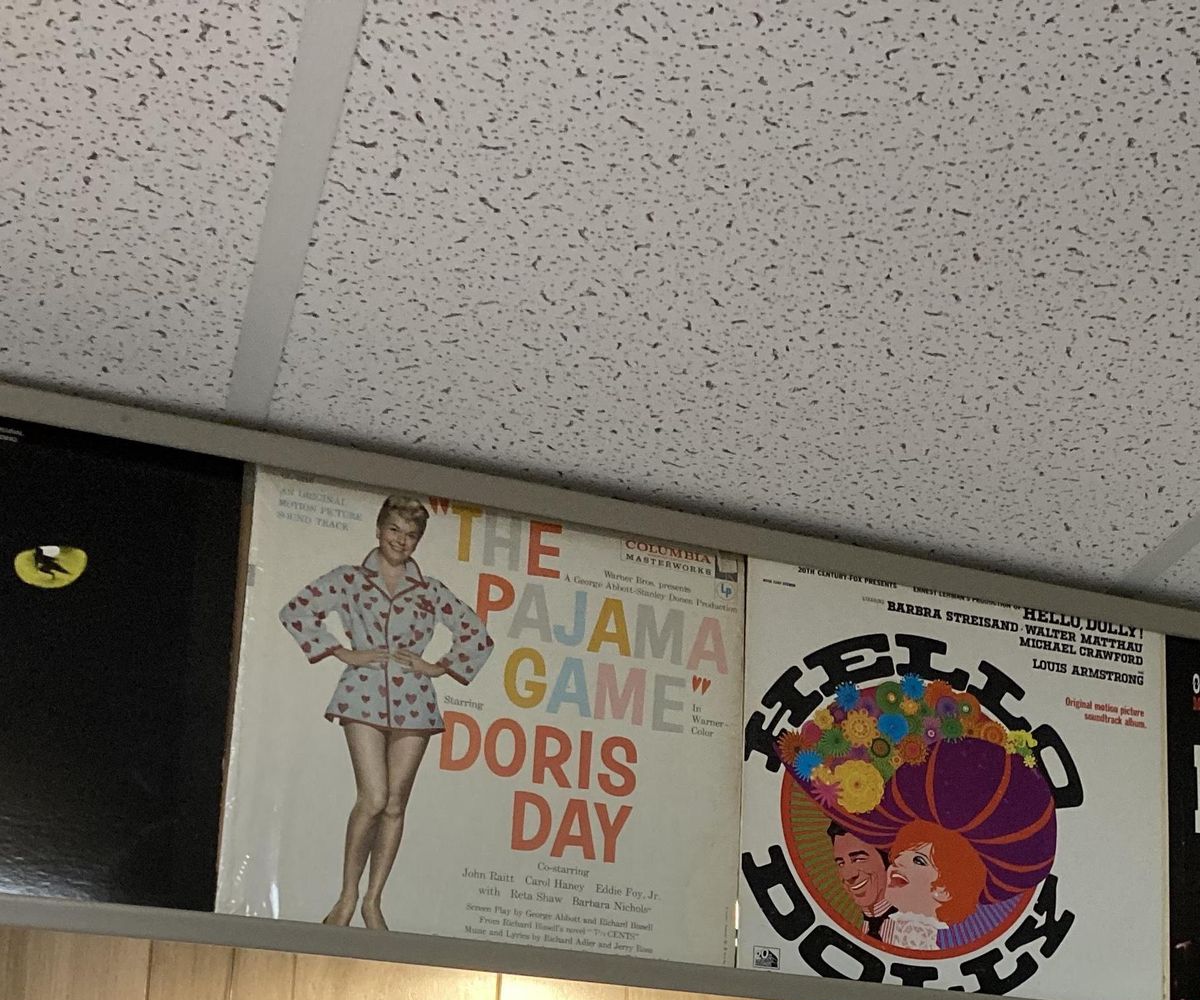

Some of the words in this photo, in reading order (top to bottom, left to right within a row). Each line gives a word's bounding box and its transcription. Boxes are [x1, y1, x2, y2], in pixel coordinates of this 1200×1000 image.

[625, 539, 712, 564] COLUMBIA
[626, 553, 712, 576] MASTERWORKS
[604, 570, 633, 583] Warner
[659, 582, 691, 593] presents
[864, 577, 897, 589] PRESENTS
[574, 576, 602, 589] George
[697, 598, 738, 614] Production
[475, 573, 728, 675] PAJAMA
[887, 600, 942, 620] BARBRA
[946, 611, 1019, 633] STREISAND
[1025, 624, 1076, 642] WALTER
[1080, 634, 1143, 653] MATTHAU
[1019, 637, 1076, 655] MICHAEL
[1079, 646, 1144, 666] CRAWFORD
[1032, 659, 1067, 674] LOUIS
[1071, 665, 1144, 686] ARMSTRONG
[444, 695, 484, 711] Starring
[1065, 697, 1092, 711] Original
[1094, 702, 1118, 714] motion
[1120, 705, 1144, 717] picture
[744, 632, 1084, 809] HELLO
[1084, 713, 1122, 726] soundtrack
[691, 727, 715, 738] Color
[439, 710, 638, 797] DORIS
[510, 791, 633, 863] DAY
[462, 867, 486, 880] John
[489, 871, 514, 883] Raitt
[525, 875, 550, 887] Carol
[554, 879, 585, 892] Haney
[596, 884, 622, 896] Eddie
[537, 862, 590, 878] Co-starring
[479, 886, 501, 897] with
[511, 889, 533, 900] Reta
[536, 892, 563, 904] Shaw
[572, 896, 610, 910] Barbara
